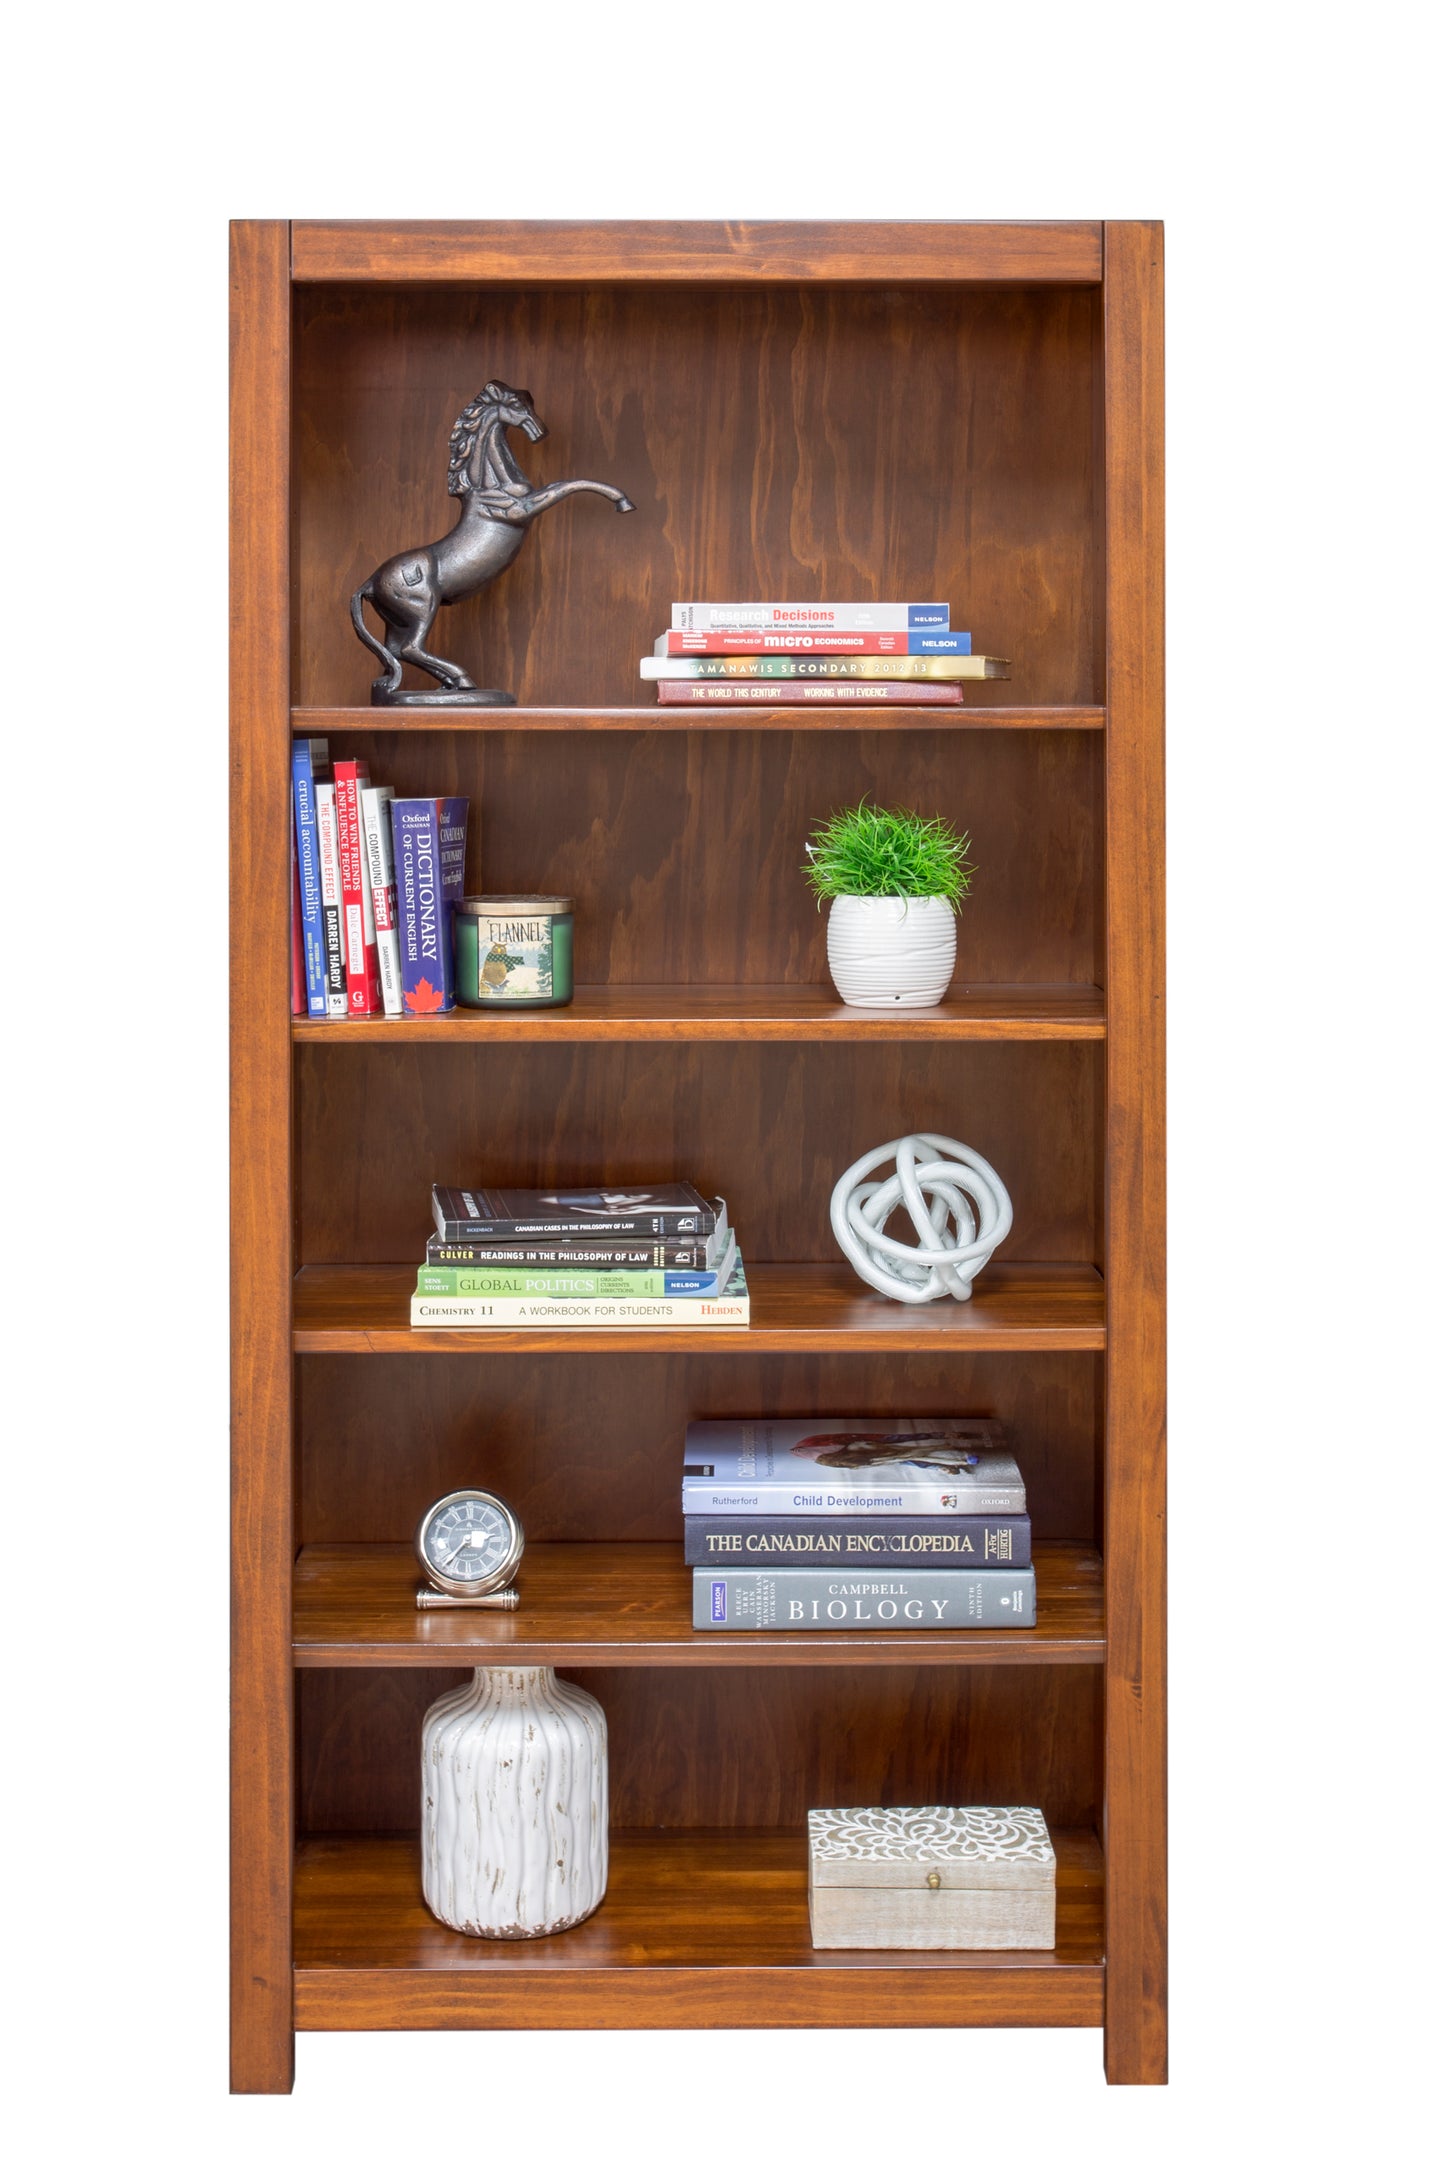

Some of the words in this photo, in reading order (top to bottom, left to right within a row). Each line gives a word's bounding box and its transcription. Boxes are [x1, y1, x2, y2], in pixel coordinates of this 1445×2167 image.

[710, 609, 769, 621] Research
[773, 609, 835, 621] Decisions
[764, 636, 813, 647] micro
[689, 664, 773, 673] TAMANAWIS
[781, 664, 866, 673] SECONDARY
[692, 688, 705, 697] THE
[707, 688, 732, 697] WORLD
[734, 688, 749, 697] THIS
[750, 688, 781, 697] CENTURY
[803, 687, 834, 697] WORKING
[837, 687, 854, 697] WITH
[856, 687, 888, 697] EVIDENCE
[337, 780, 345, 788] &
[346, 779, 356, 804] HOW
[298, 780, 313, 825] crucial
[321, 803, 330, 818] THE
[338, 791, 349, 849] INFLUENCE
[348, 806, 357, 820] TO
[402, 813, 430, 823] Oxford
[349, 823, 358, 844] WIN
[367, 815, 377, 832] THE
[322, 820, 333, 865] COMPOUND
[402, 834, 413, 850] OF
[350, 847, 360, 891] FRIENDS
[368, 833, 383, 886] COMPOUND
[301, 829, 319, 924] accountability
[342, 852, 352, 891] PEOPLE
[403, 852, 415, 911] CURRENT
[324, 867, 335, 900] EFFECT
[374, 888, 388, 926] EFFECT
[417, 833, 437, 961] DICTIONARY
[350, 907, 358, 928] Dale
[326, 911, 339, 951] DARREN
[406, 913, 418, 962] ENGLISH
[487, 919, 544, 943] FLANNEL
[351, 931, 360, 972] Carnegie
[382, 945, 390, 970] DARREN
[329, 954, 341, 988] HARDY
[384, 970, 393, 990] HARDY
[352, 991, 363, 1002] G
[440, 1251, 474, 1259] CULVER
[481, 1251, 524, 1260] READINGS
[527, 1252, 537, 1260] IN
[539, 1252, 555, 1261] THE
[558, 1252, 613, 1261] PHILOSOPHY
[615, 1253, 626, 1261] OF
[628, 1253, 649, 1261] LAW
[459, 1279, 522, 1291] GLOBAL
[525, 1279, 595, 1291] POLITICS
[481, 1305, 494, 1316] 11
[519, 1307, 527, 1315] A
[530, 1306, 591, 1315] WORKBOOK
[595, 1306, 616, 1315] FOR
[619, 1306, 673, 1315] STUDENTS
[712, 1496, 758, 1505] Rutherford
[793, 1495, 823, 1506] Child
[827, 1495, 903, 1508] Development
[705, 1535, 742, 1551] THE
[746, 1534, 842, 1551] CANADIAN
[846, 1534, 975, 1552] ENCYCLOPEDIA
[828, 1584, 908, 1595] CAMPBELL
[788, 1599, 949, 1620] BIOLOGY
